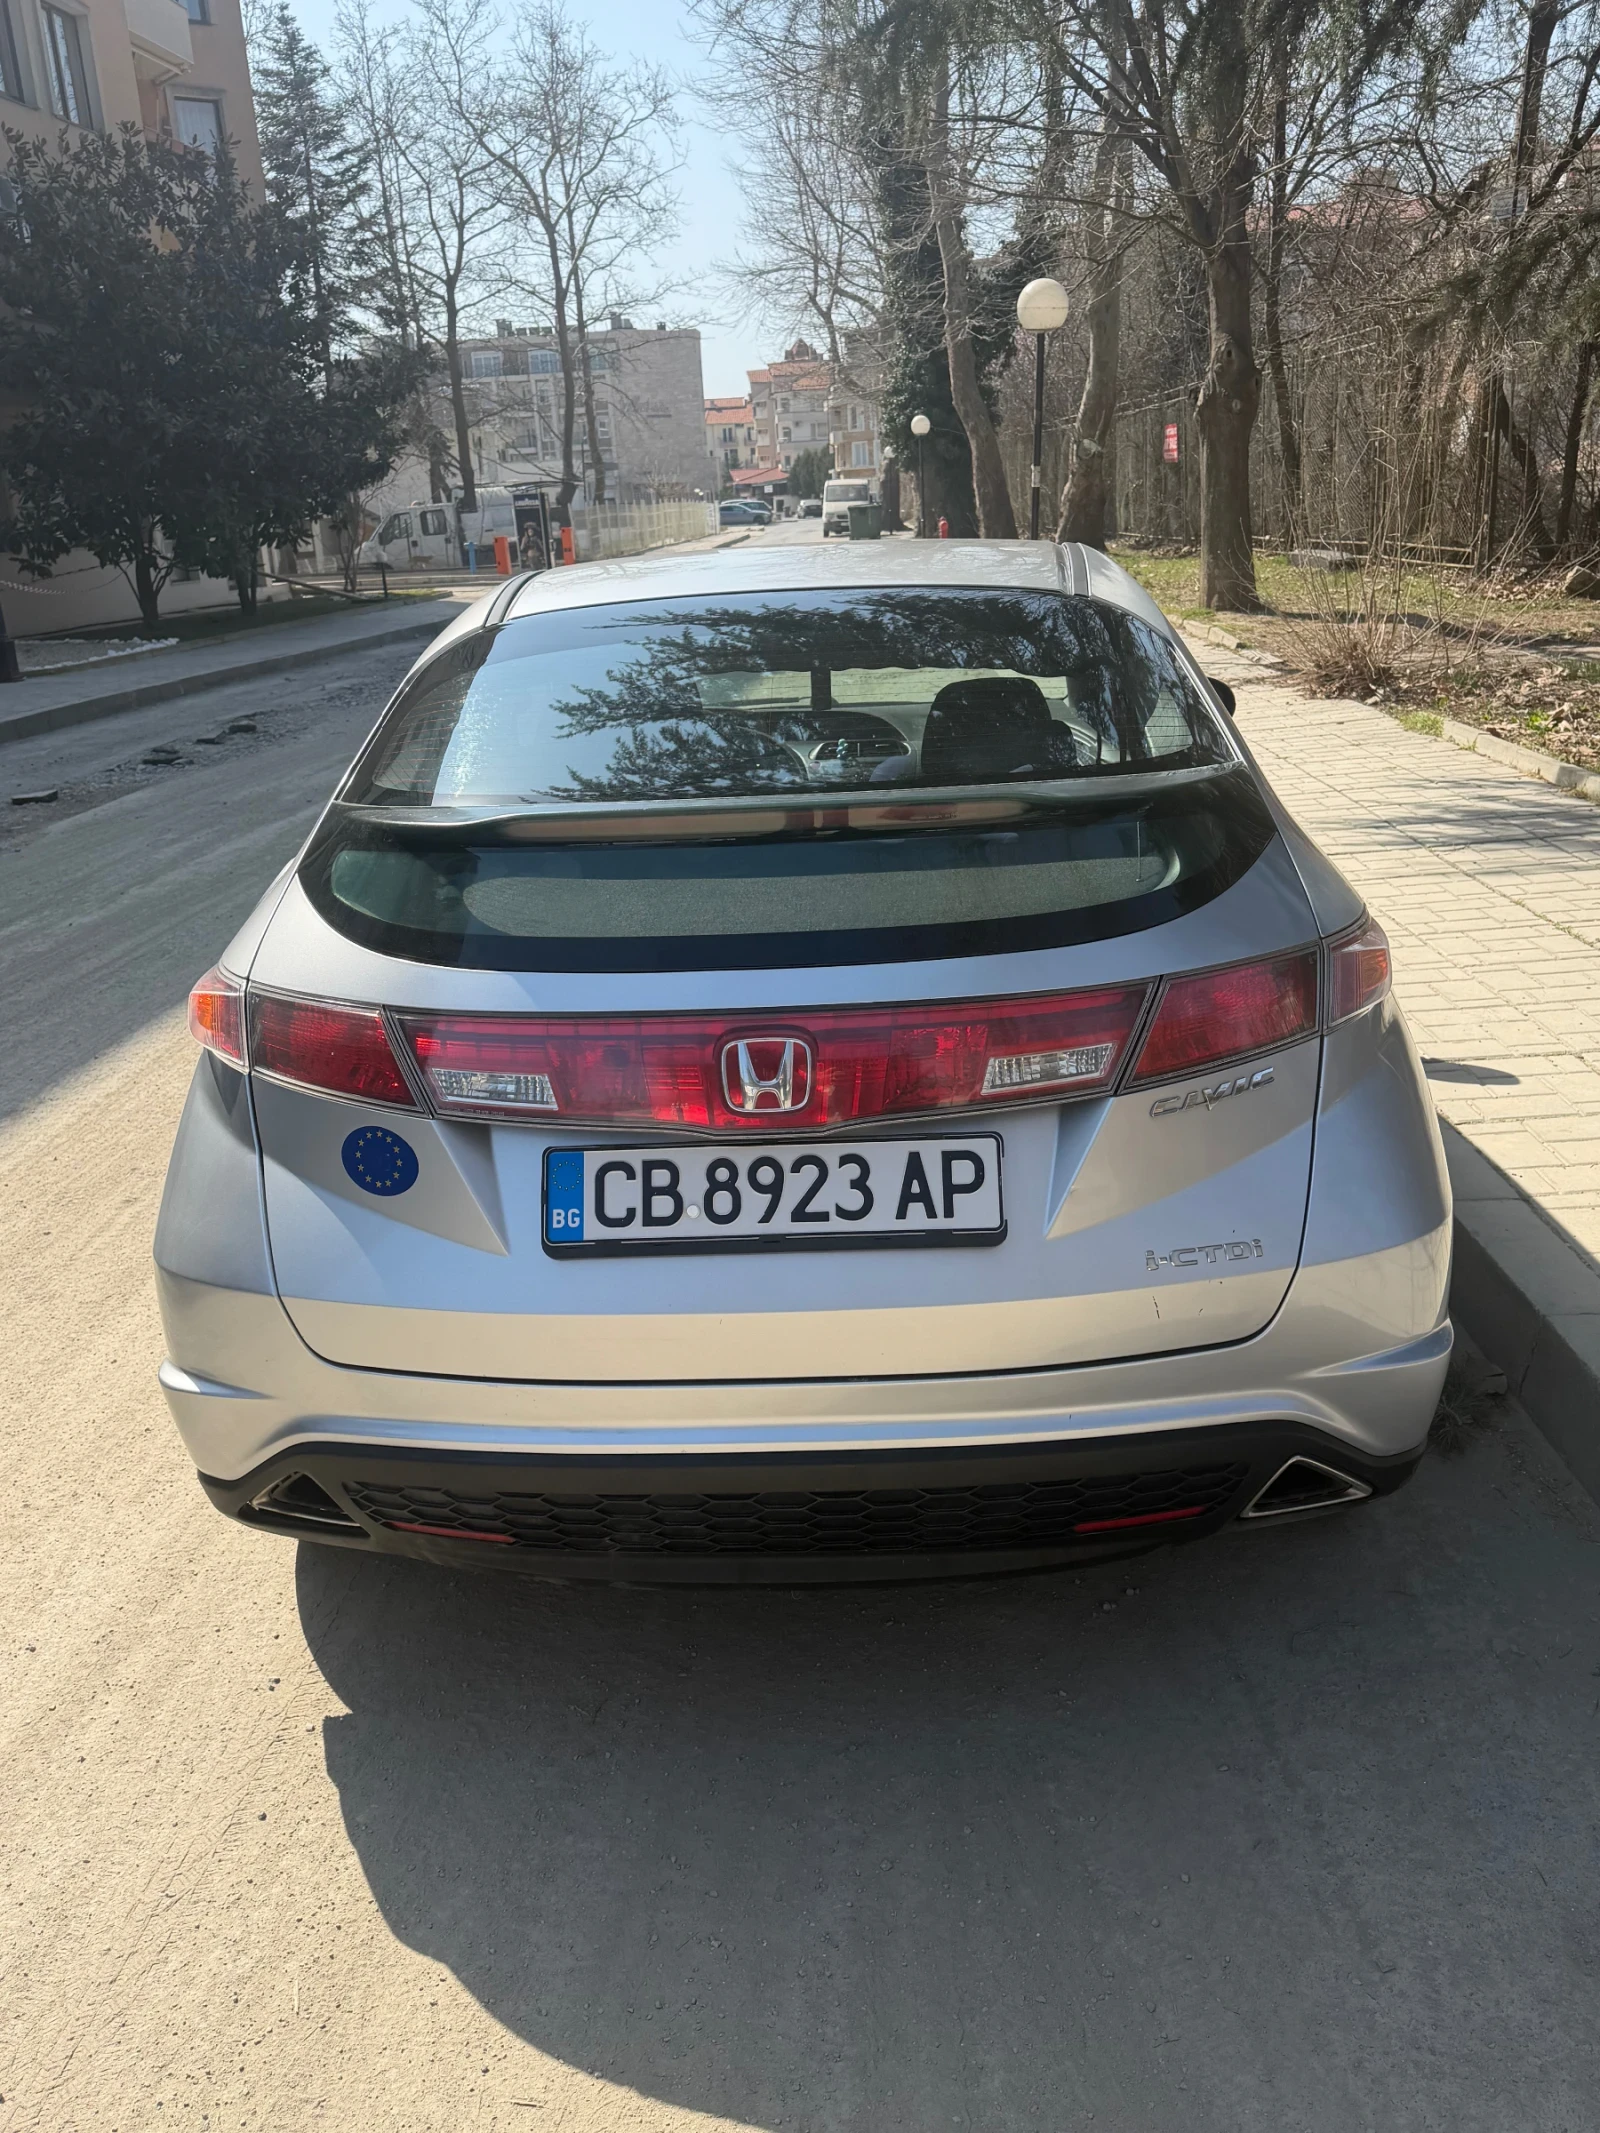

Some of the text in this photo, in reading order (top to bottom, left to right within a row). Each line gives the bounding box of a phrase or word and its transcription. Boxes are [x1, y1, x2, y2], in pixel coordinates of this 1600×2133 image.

[1150, 1066, 1275, 1117] CIVIC
[594, 1150, 985, 1228] CB 8923 AP
[552, 1208, 580, 1228] BG
[1145, 1238, 1263, 1271] i-CTDi
